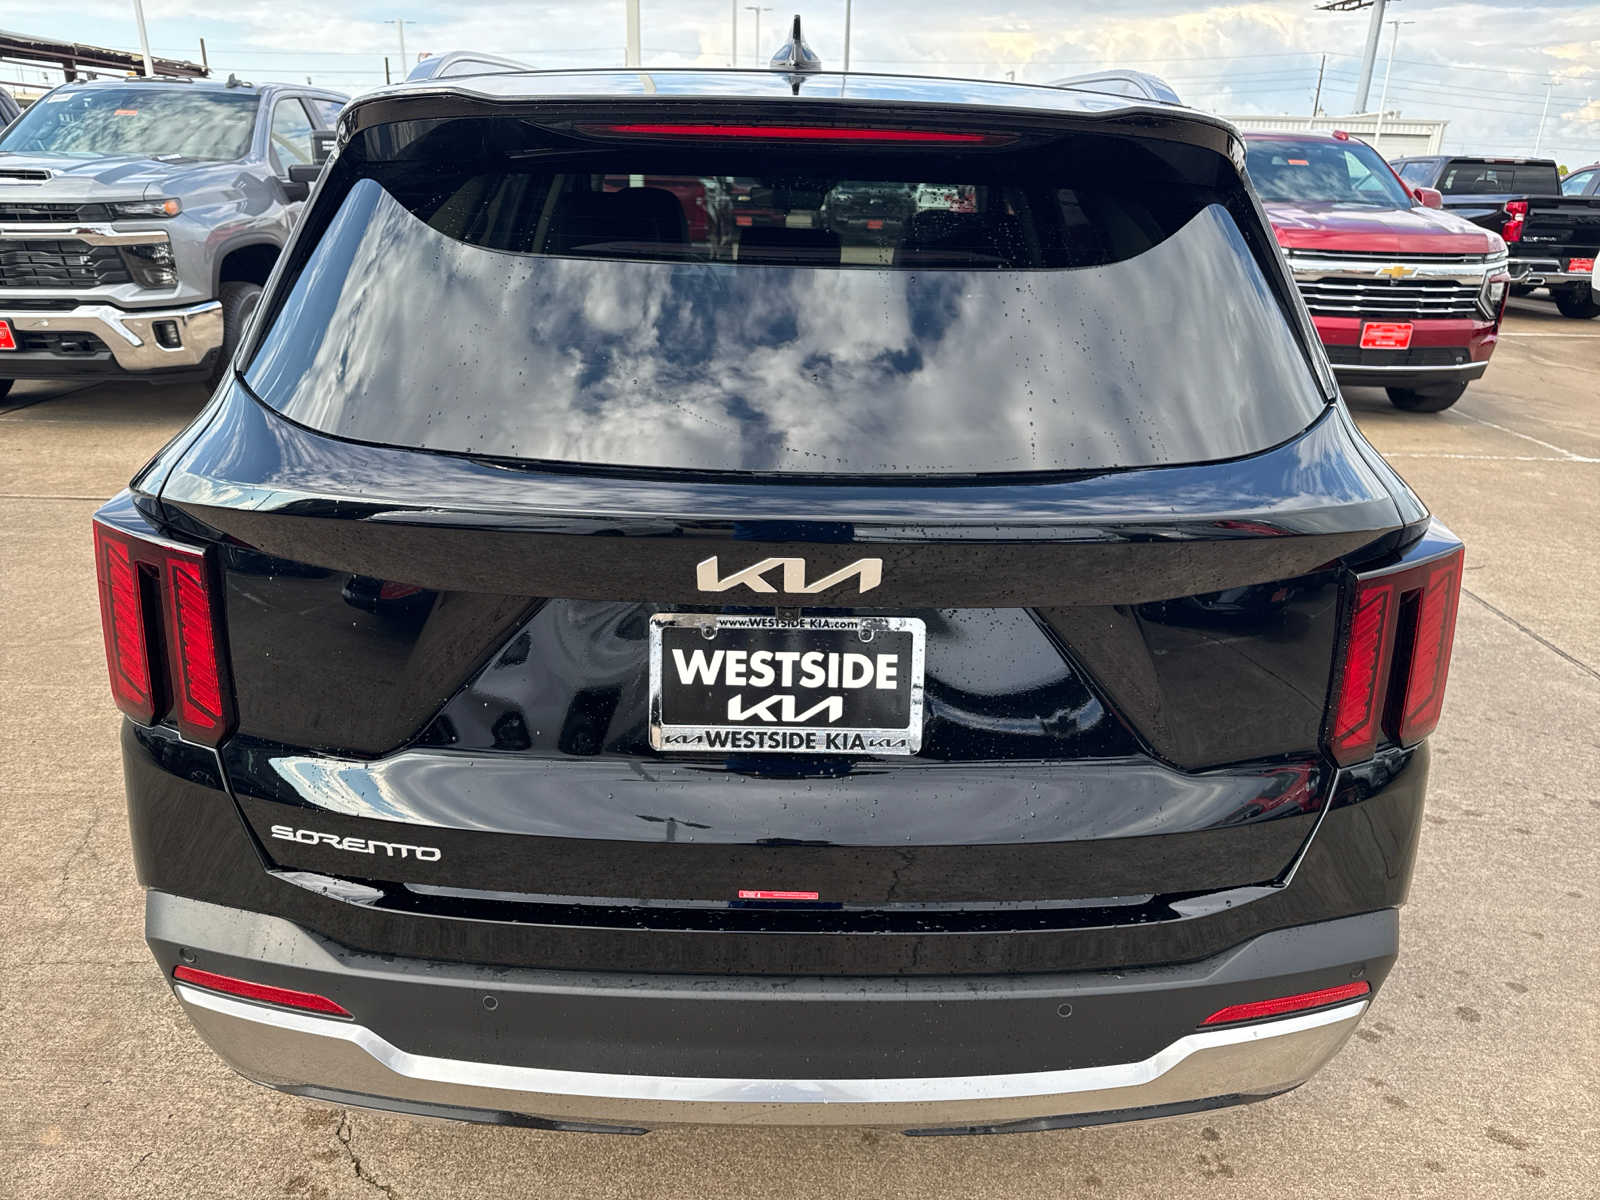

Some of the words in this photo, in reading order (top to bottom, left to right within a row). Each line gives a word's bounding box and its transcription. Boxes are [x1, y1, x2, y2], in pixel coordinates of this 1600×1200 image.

[697, 555, 883, 594] KIA
[719, 617, 806, 629] www.WESTSIDE
[809, 618, 858, 630] KIA.com
[671, 648, 899, 690] WESTSIDE
[727, 693, 844, 723] KIA
[664, 734, 703, 744] KIA
[705, 730, 817, 750] WESTSIDE
[826, 732, 867, 751] KIA
[868, 737, 906, 747] KIA
[270, 824, 442, 862] SORENTO
